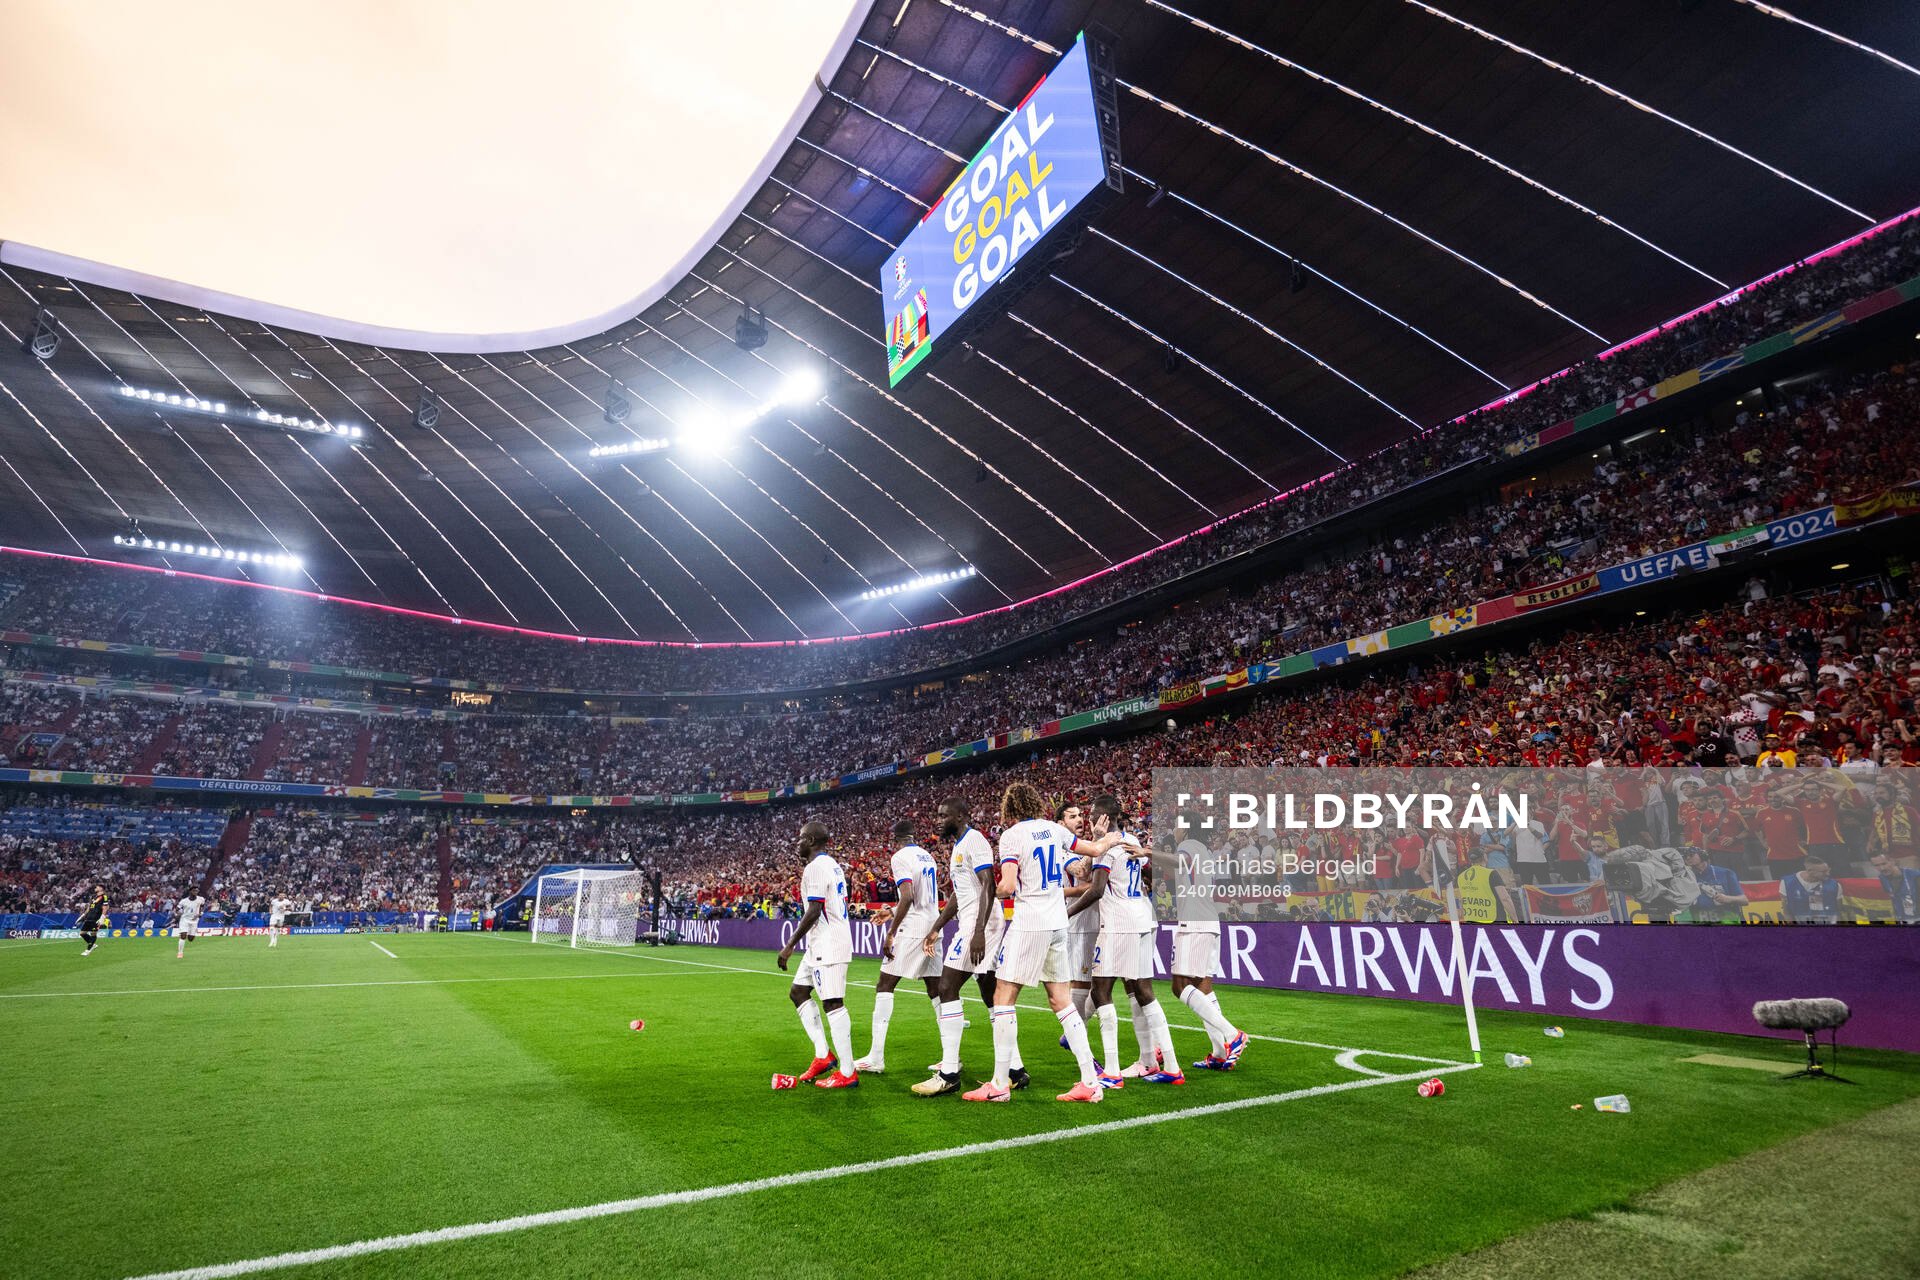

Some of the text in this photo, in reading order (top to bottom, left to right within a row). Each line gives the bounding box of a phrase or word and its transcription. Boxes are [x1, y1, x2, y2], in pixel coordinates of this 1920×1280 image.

[944, 101, 1055, 233] GOAL
[953, 150, 1054, 265] GOAL
[952, 185, 1067, 310] GOAL
[1771, 511, 1837, 544] 2024
[1033, 844, 1062, 890] 14
[1126, 859, 1142, 898] 12
[9, 929, 39, 938] QATAR
[678, 919, 720, 945] AIRWAYS
[953, 938, 962, 956] 4
[1290, 924, 1614, 1011] AIRWAYS
